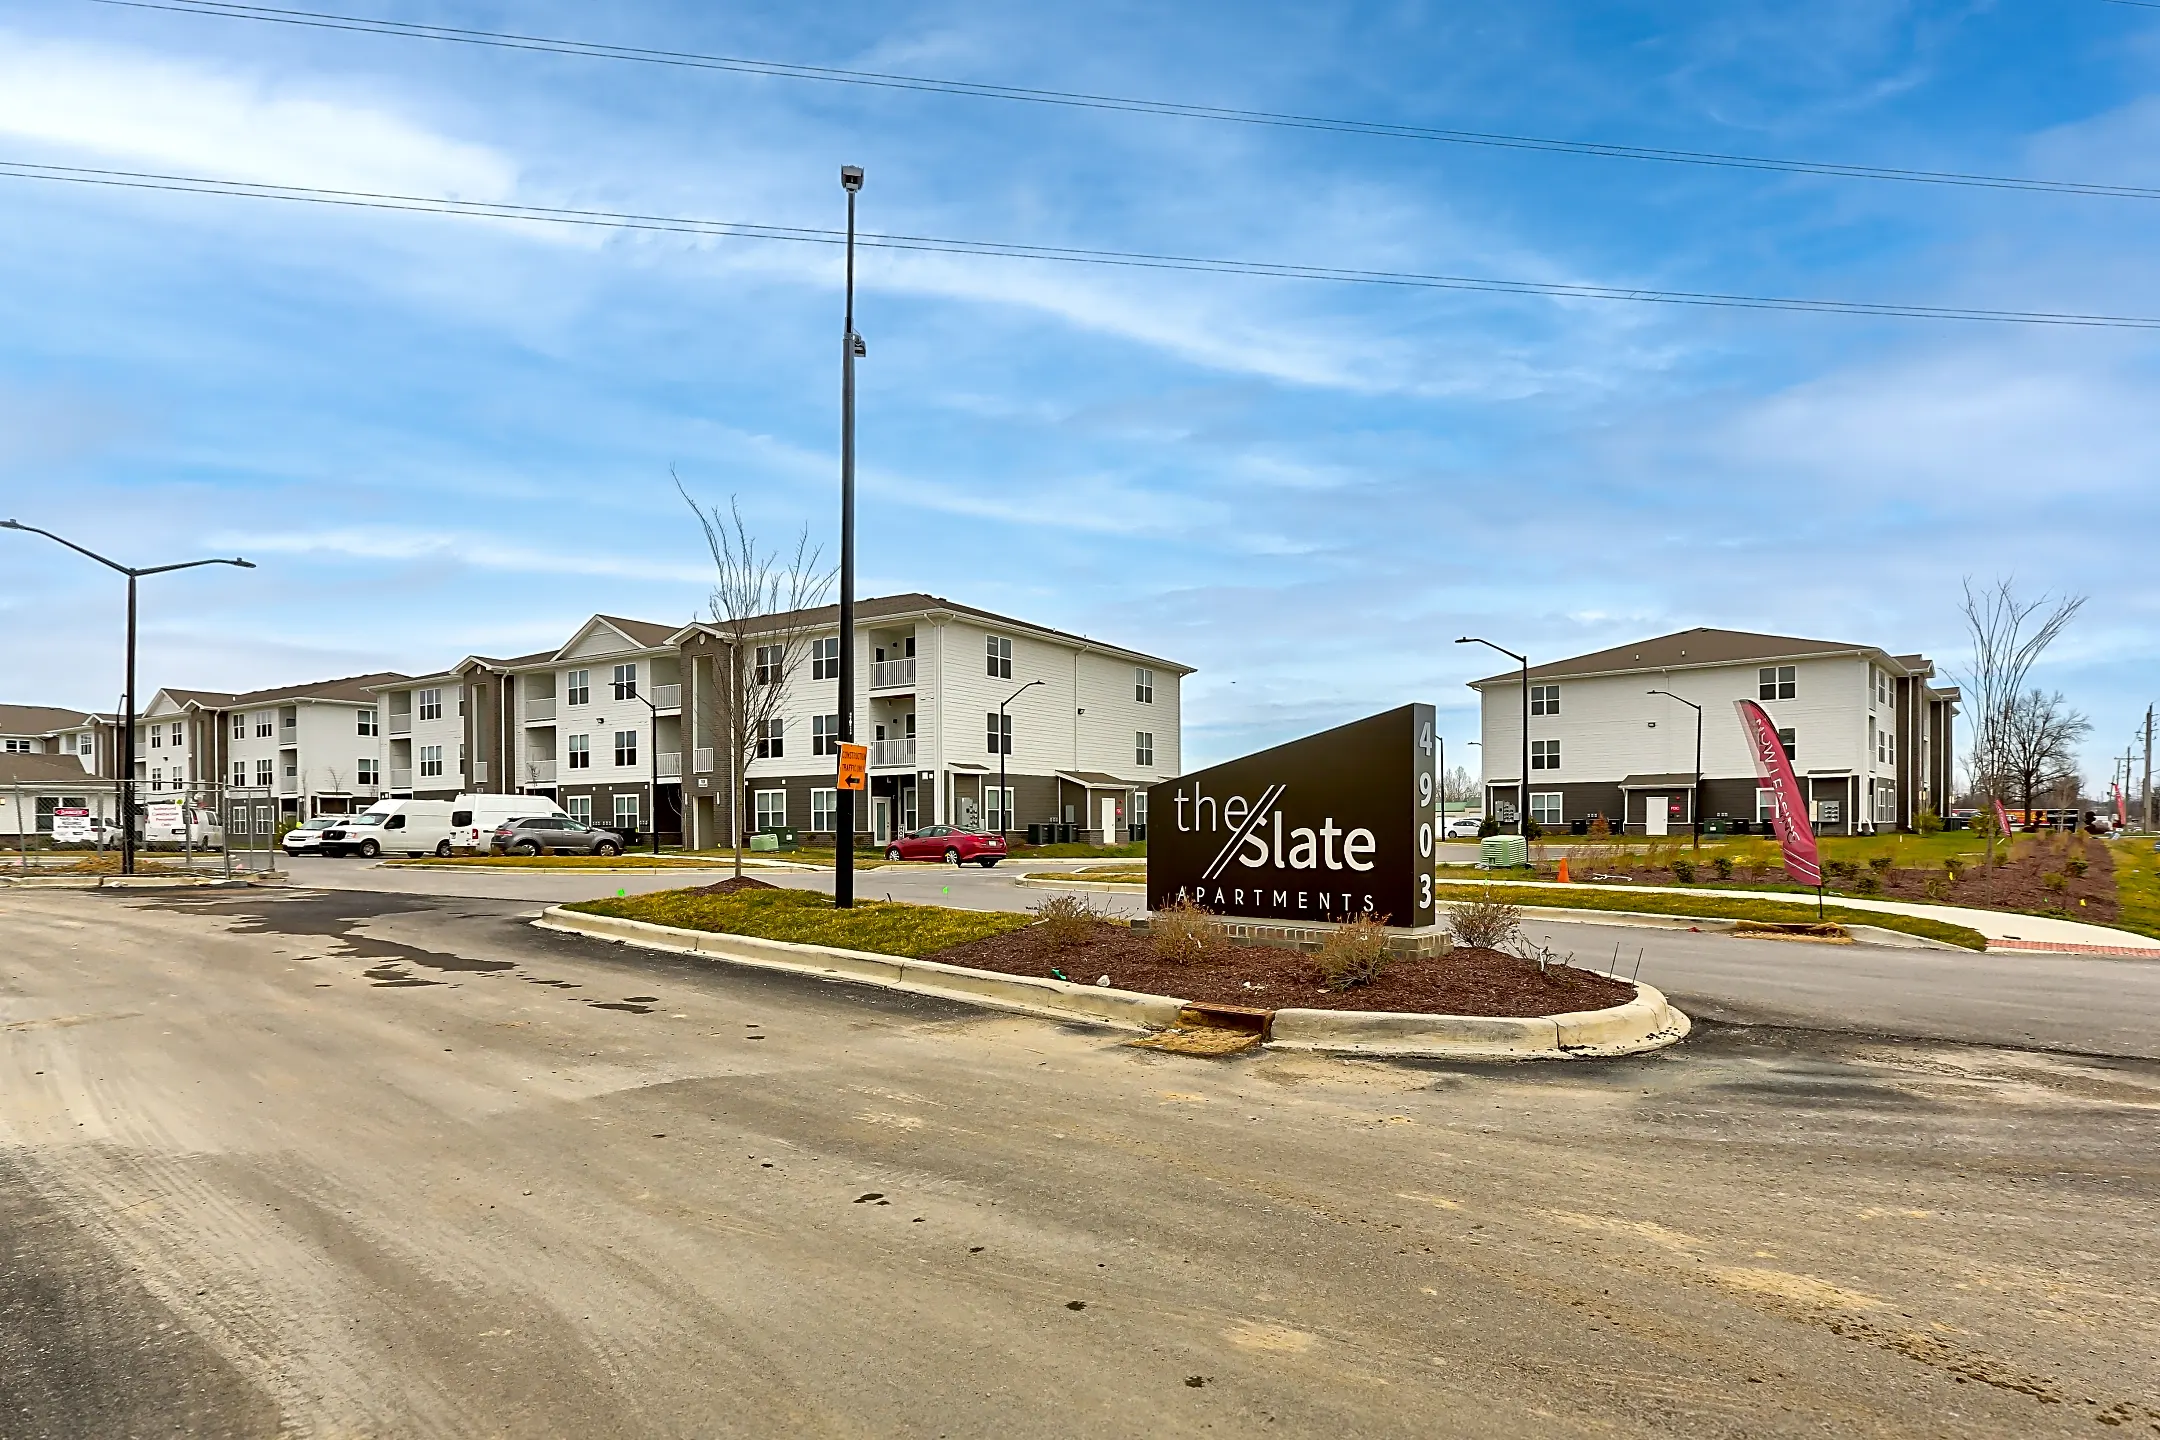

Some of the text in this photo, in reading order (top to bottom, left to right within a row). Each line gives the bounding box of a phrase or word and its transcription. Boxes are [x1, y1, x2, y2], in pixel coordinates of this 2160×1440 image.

[1755, 717, 1778, 763] NOW
[842, 763, 857, 772] TRAFFIC
[1173, 781, 1249, 832] the
[1419, 721, 1433, 910] 4903
[1177, 885, 1375, 913] APARTMENTS
